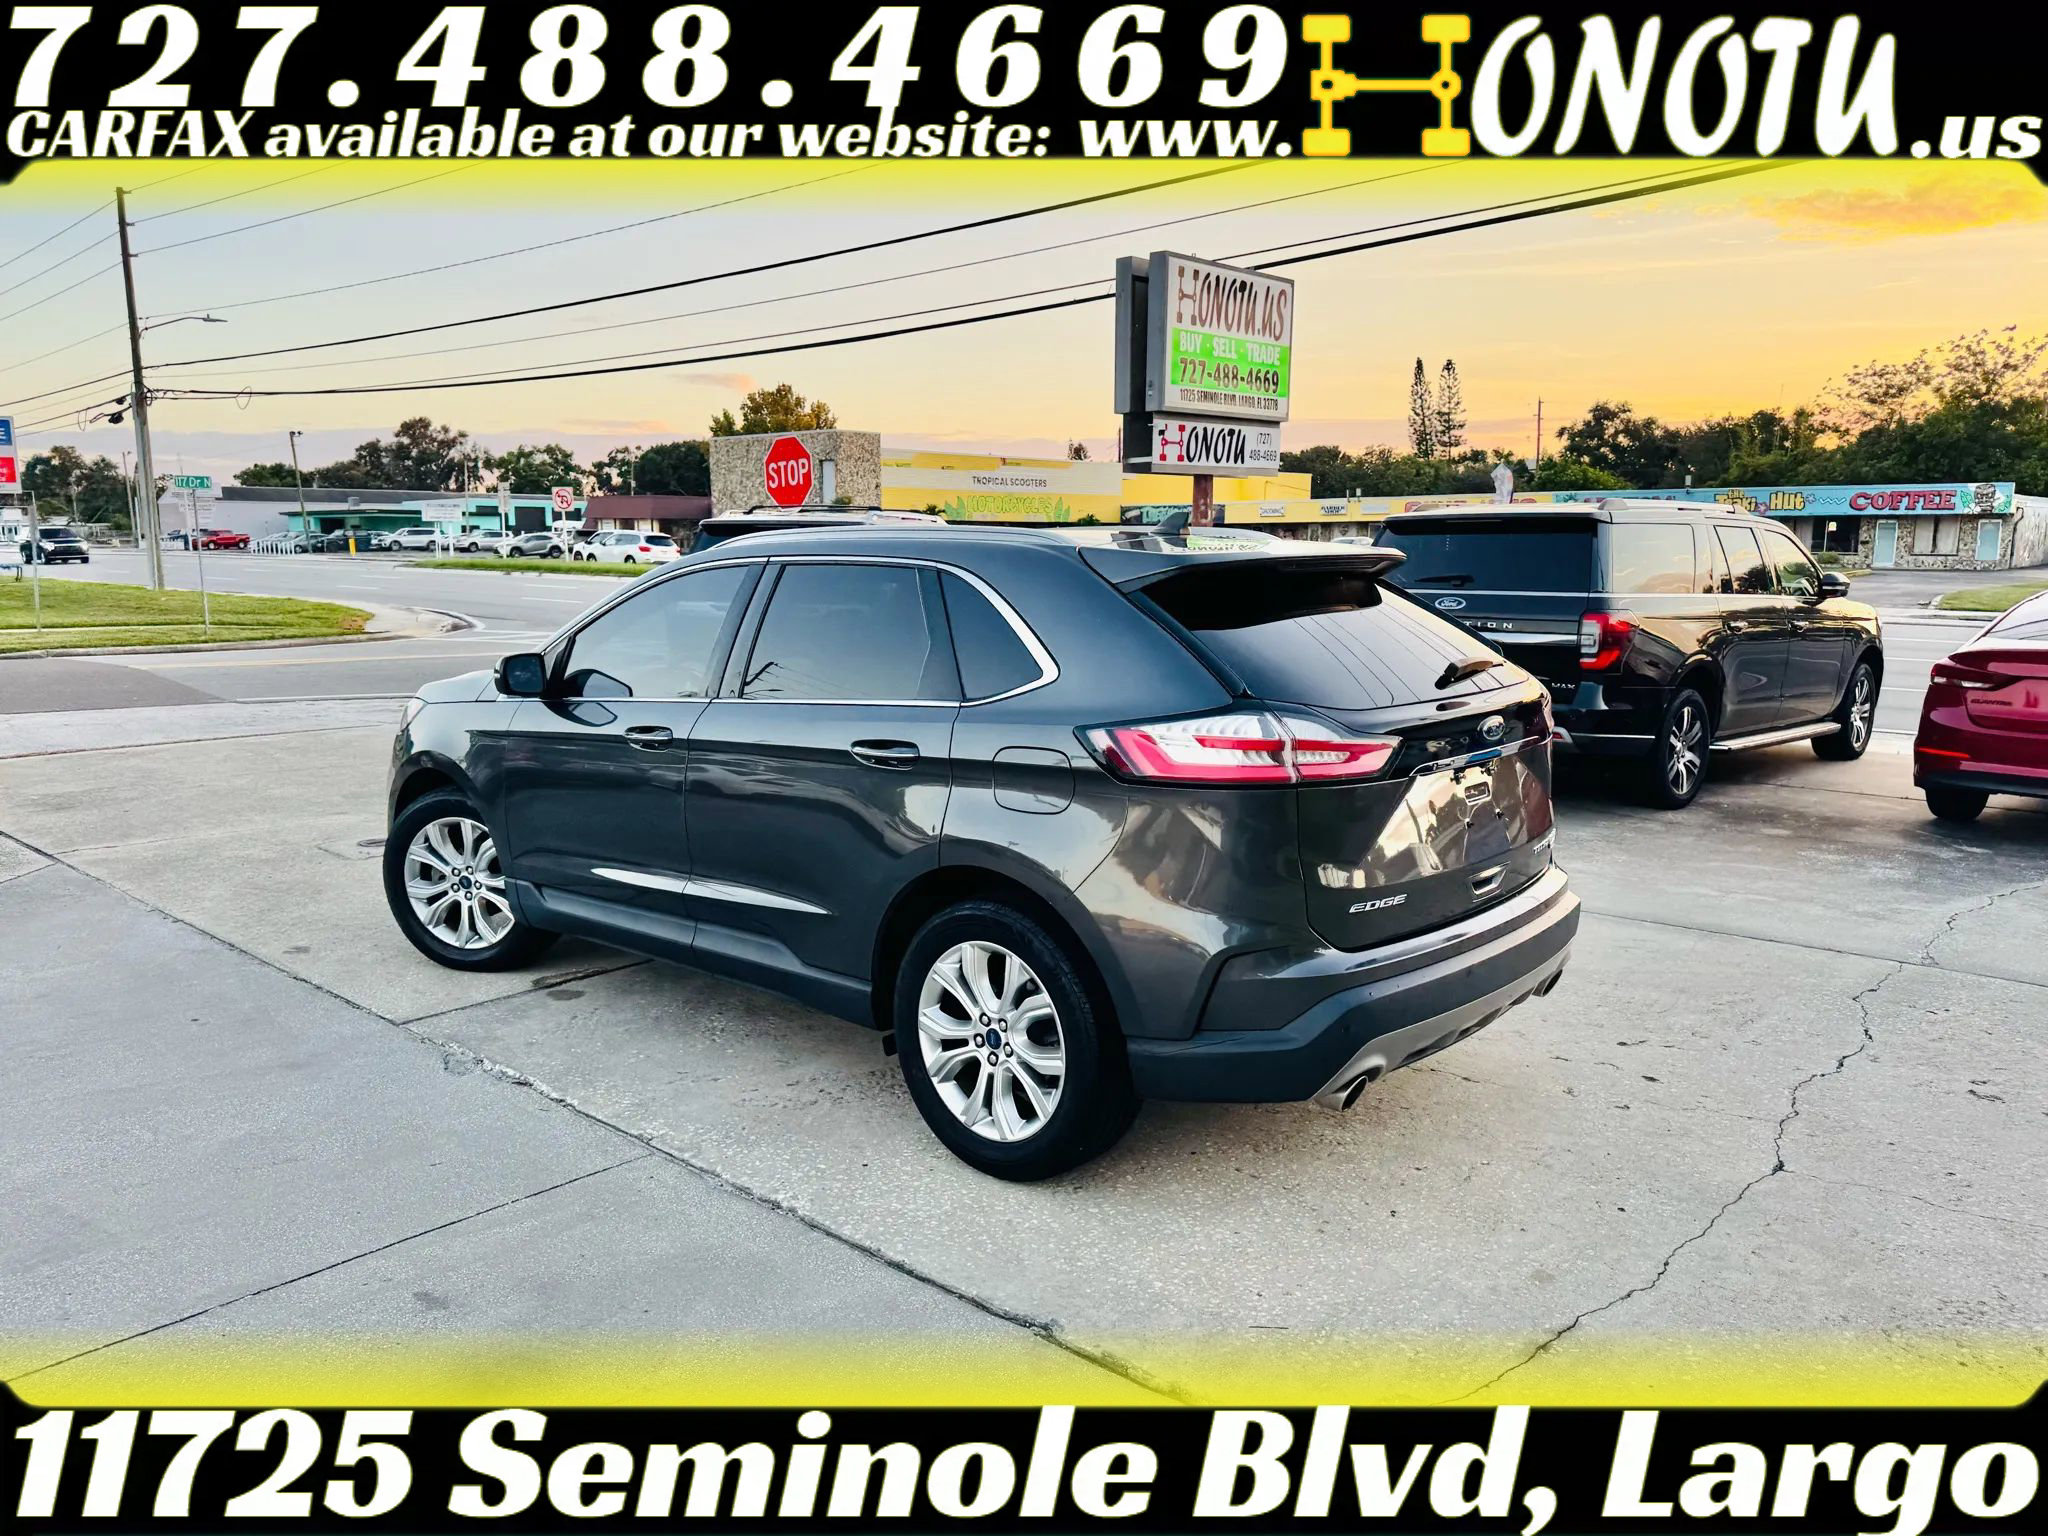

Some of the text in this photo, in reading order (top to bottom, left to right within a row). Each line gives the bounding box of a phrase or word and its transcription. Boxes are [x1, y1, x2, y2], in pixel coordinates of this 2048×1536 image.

[1180, 331, 1281, 366] BUY SELL TRADE
[1180, 357, 1280, 394] 727-488-4669
[1180, 388, 1196, 403] 11725
[1196, 390, 1223, 405] SEMINOLE
[1256, 432, 1273, 447] (727)
[176, 477, 211, 487] 117 Dr N
[768, 458, 809, 489] STOP
[972, 475, 1048, 488] TROPICAL SCOOTERS
[966, 495, 1054, 514] MOTORCYCLES
[1769, 491, 1806, 511] Hut
[1849, 489, 1957, 511] COFFEE
[1349, 893, 1408, 914] EDGE
